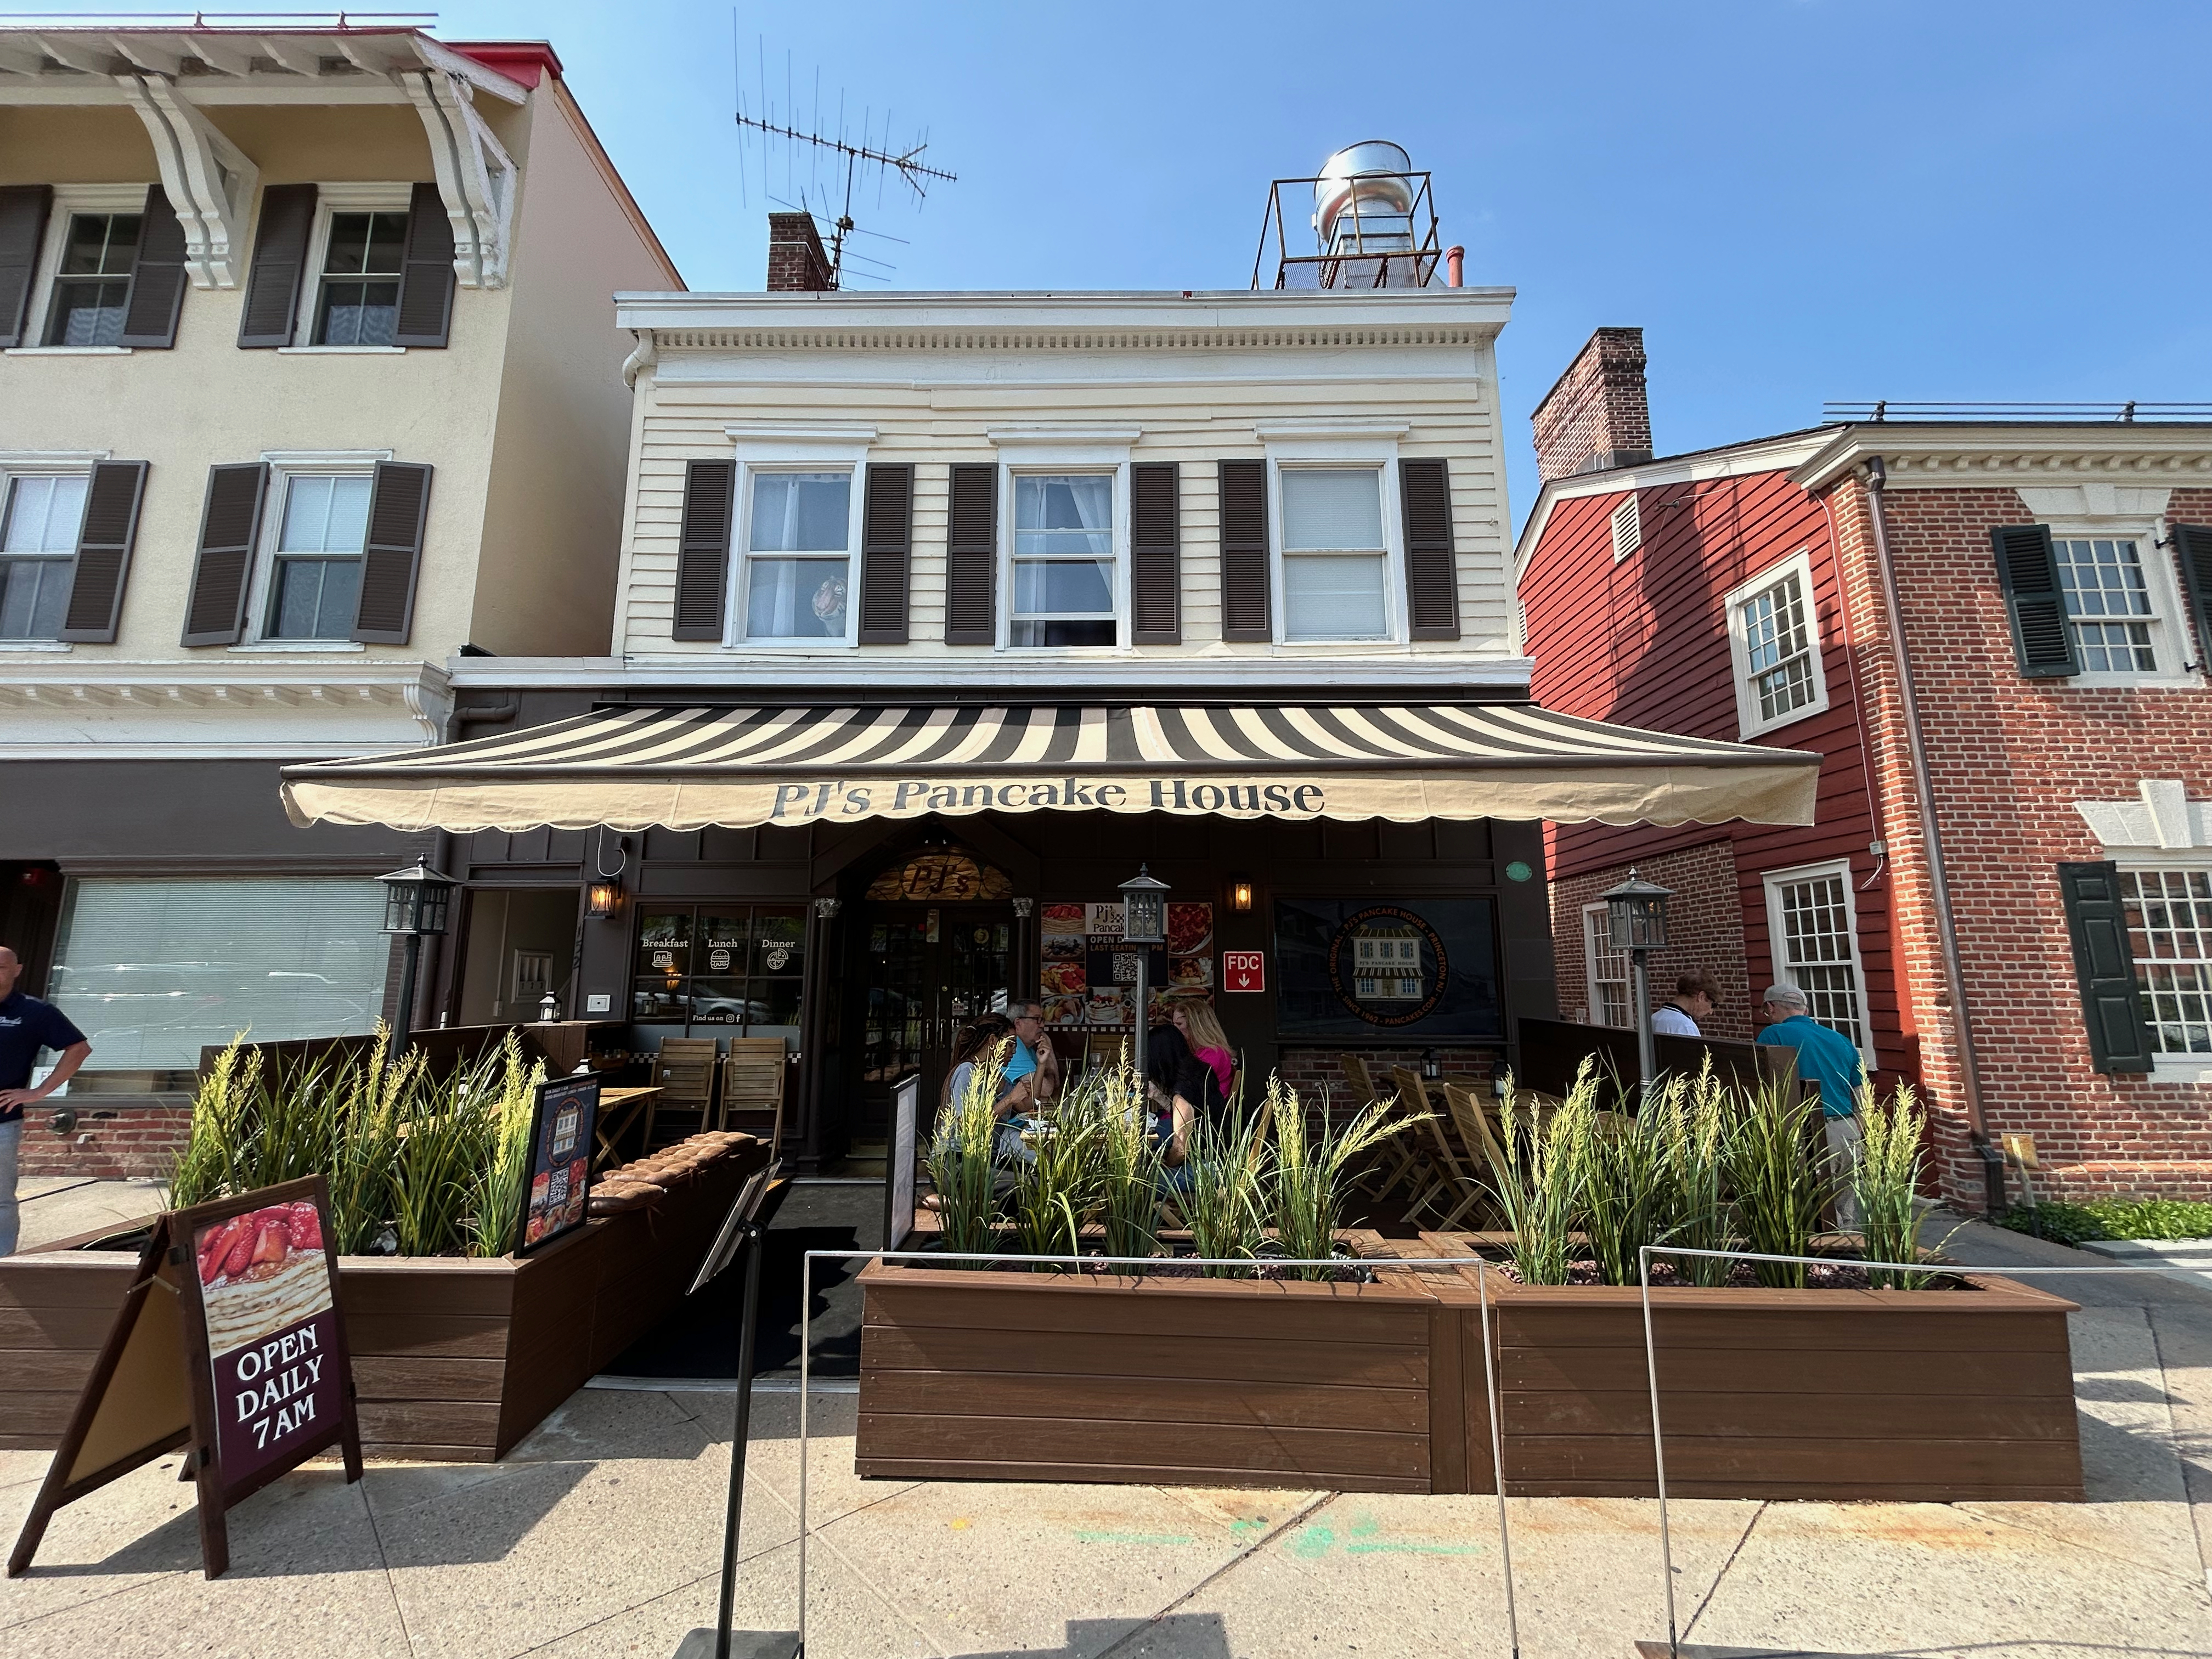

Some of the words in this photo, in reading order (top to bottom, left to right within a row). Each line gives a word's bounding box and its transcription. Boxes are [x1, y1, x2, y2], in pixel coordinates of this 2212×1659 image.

[770, 782, 873, 819] PJ's
[891, 777, 1127, 811] Pancake
[1148, 778, 1326, 813] House
[909, 865, 970, 894] PJ's
[1093, 923, 1125, 932] Pancak
[1343, 916, 1358, 931] PJ'S
[1358, 908, 1398, 921] PANCAKE
[1400, 910, 1427, 930] HOUSE
[642, 938, 689, 948] Breakfast
[708, 938, 738, 948] Lunch
[761, 939, 795, 949] Dinner
[1090, 936, 1115, 944] OPEN
[1227, 955, 1259, 970] FDC
[1329, 934, 1344, 974] ORIGINAL
[1427, 932, 1447, 974] PRINCETON
[1331, 975, 1343, 992] THE
[1435, 974, 1446, 993] NJ
[1342, 995, 1361, 1014] SINCE
[1361, 1011, 1379, 1023] 1962
[1384, 995, 1436, 1025] PANCAKES.COM
[236, 1323, 319, 1382] OPEN
[236, 1353, 324, 1423] DAILY
[252, 1392, 317, 1450] 7AM
